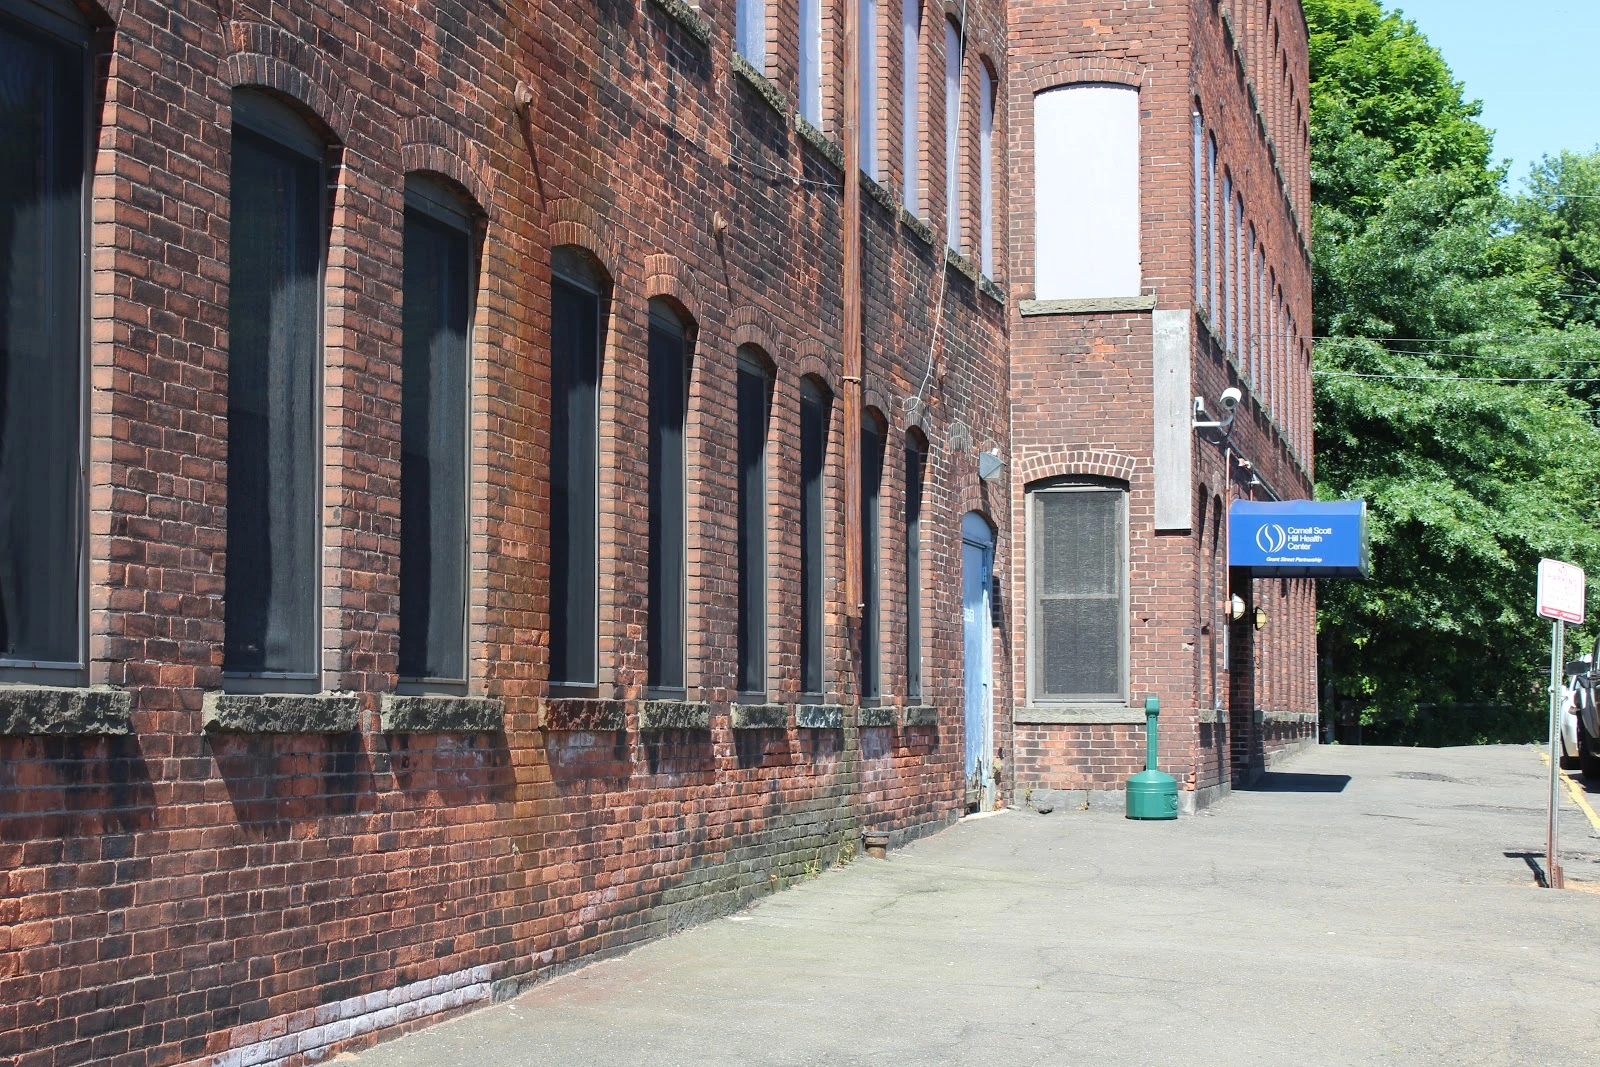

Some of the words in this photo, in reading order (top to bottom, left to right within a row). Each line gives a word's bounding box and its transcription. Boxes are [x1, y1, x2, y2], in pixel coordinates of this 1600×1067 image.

[1287, 526, 1313, 535] Cornell
[1313, 526, 1332, 535] Scott
[1287, 542, 1311, 550] Center
